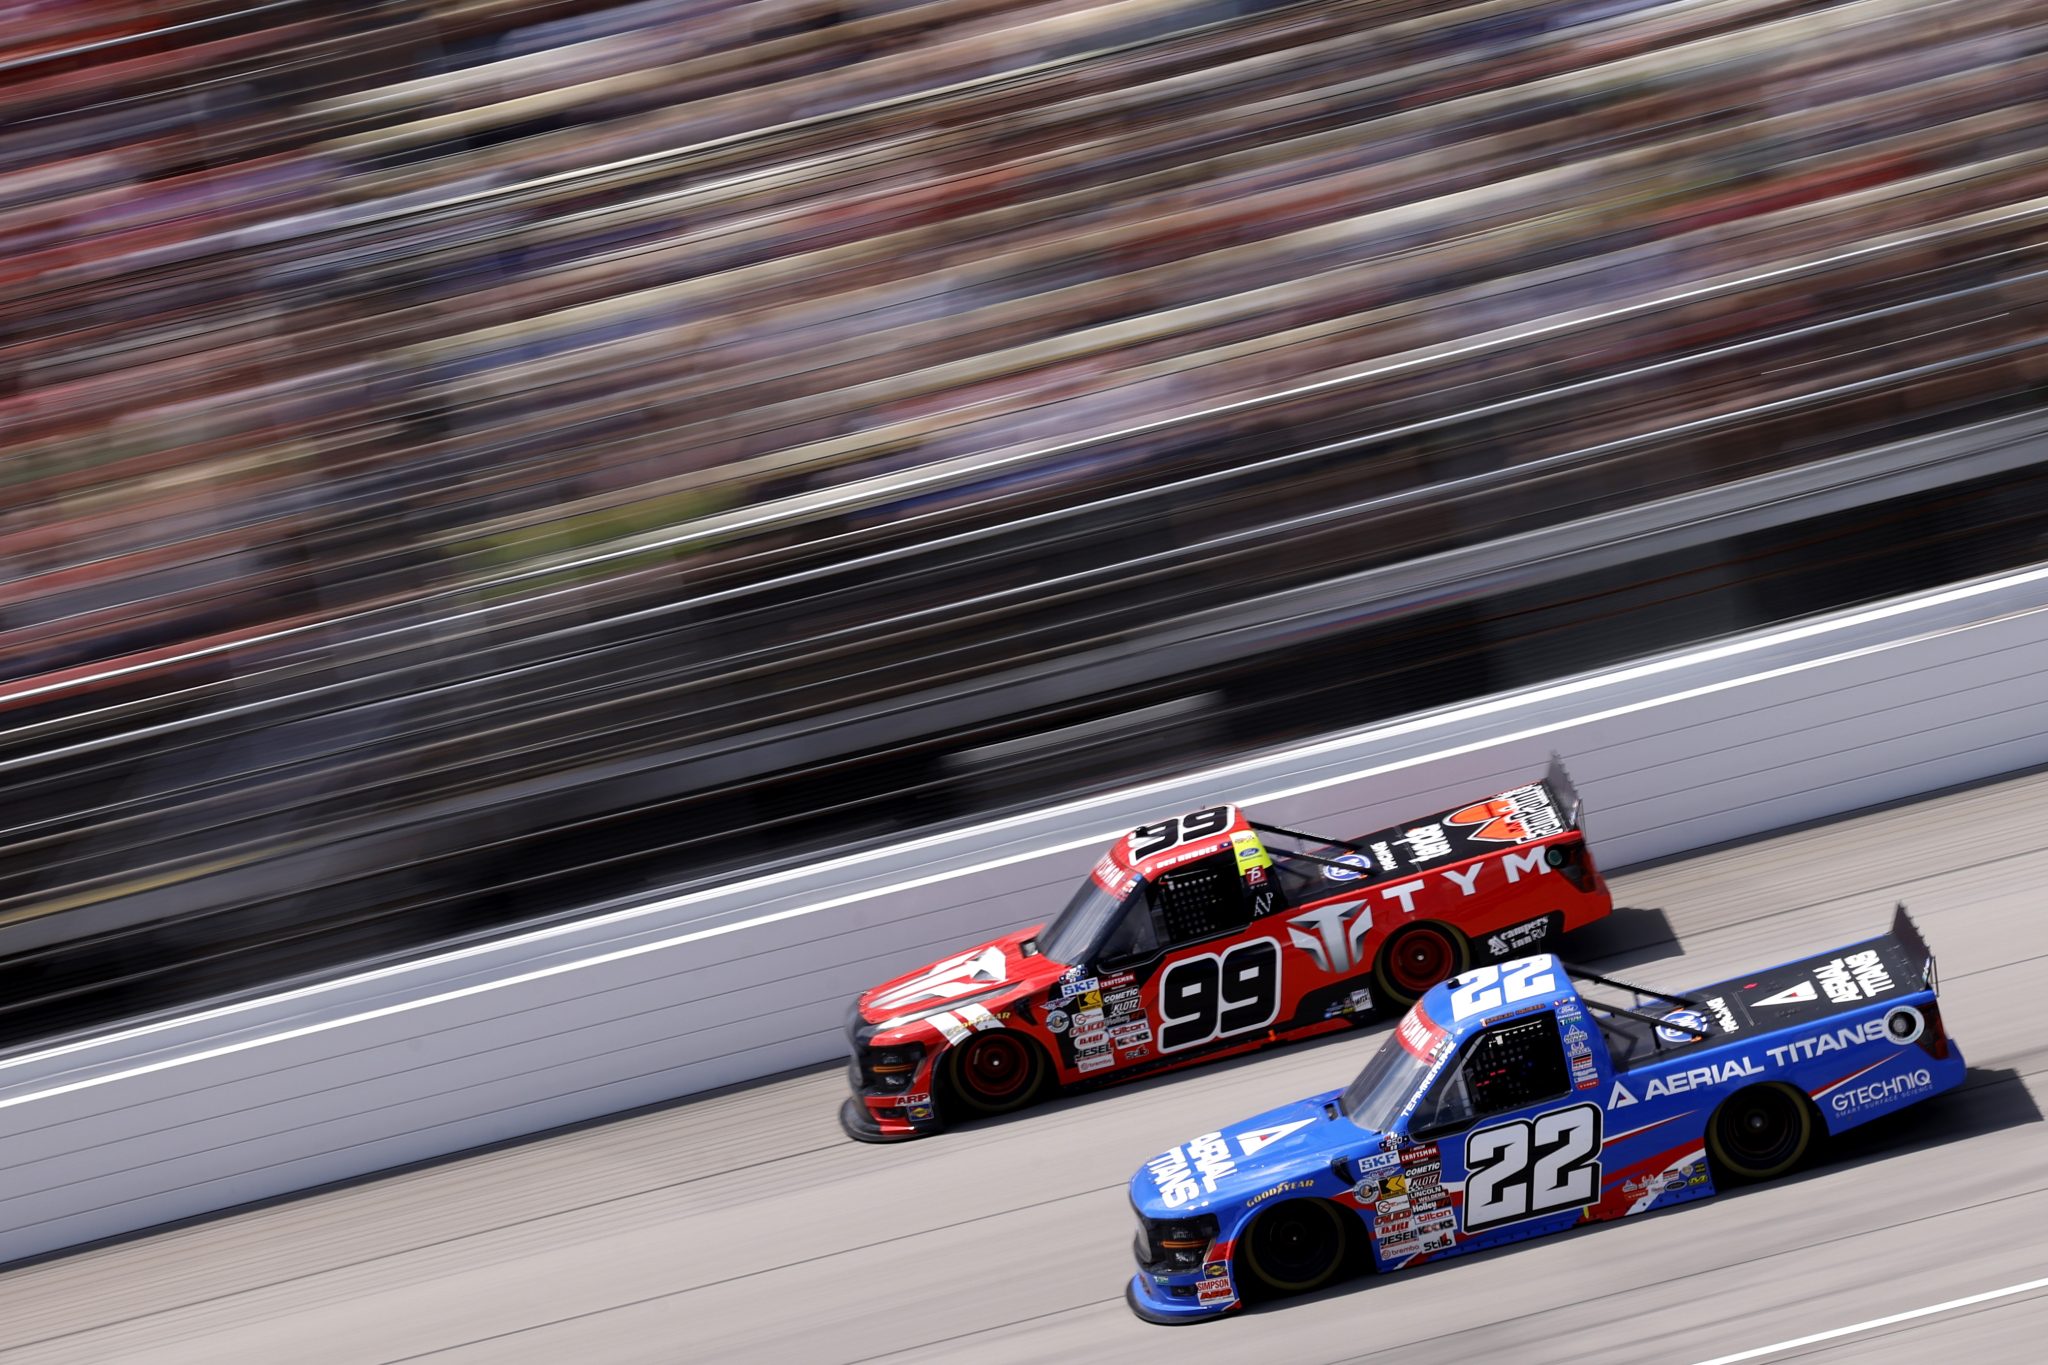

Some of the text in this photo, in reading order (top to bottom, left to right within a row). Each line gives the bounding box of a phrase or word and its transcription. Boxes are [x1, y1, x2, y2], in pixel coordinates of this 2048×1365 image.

[1127, 804, 1236, 866] 99
[1500, 914, 1549, 941] campers
[1099, 975, 1135, 988] CRAFTSMAN
[1812, 958, 1863, 1004] AERIAL
[1845, 950, 1896, 998] TITANS
[1064, 980, 1097, 996] SKF
[1103, 988, 1138, 1003] COMETIC
[1158, 936, 1282, 1054] 99
[1450, 953, 1557, 1022] 22
[1112, 999, 1139, 1014] KLOTZ
[1110, 1023, 1147, 1036] tilton
[1075, 1043, 1113, 1060] JESEL
[1645, 1018, 1885, 1101] AERIAL TITANS
[1832, 1069, 1931, 1111] GTECHNIQ
[896, 1093, 929, 1107] ARP
[1362, 1152, 1397, 1171] SKF
[1401, 1147, 1438, 1162] CRAFTSMAN
[1405, 1162, 1440, 1177] COMETIC
[1463, 1101, 1603, 1235] 22
[1410, 1174, 1438, 1189] KLOTZ
[1246, 1179, 1315, 1208] GOODYEAR
[1410, 1185, 1442, 1199] LINCOLN
[1419, 1192, 1446, 1203] WELDERS
[1413, 1200, 1437, 1213] Holley
[1417, 1210, 1452, 1223] tilton
[1418, 1219, 1455, 1236] KOOKS
[1379, 1230, 1419, 1247] JESEL
[1391, 1243, 1420, 1256] brembo
[1197, 1279, 1230, 1292] SIMPSON
